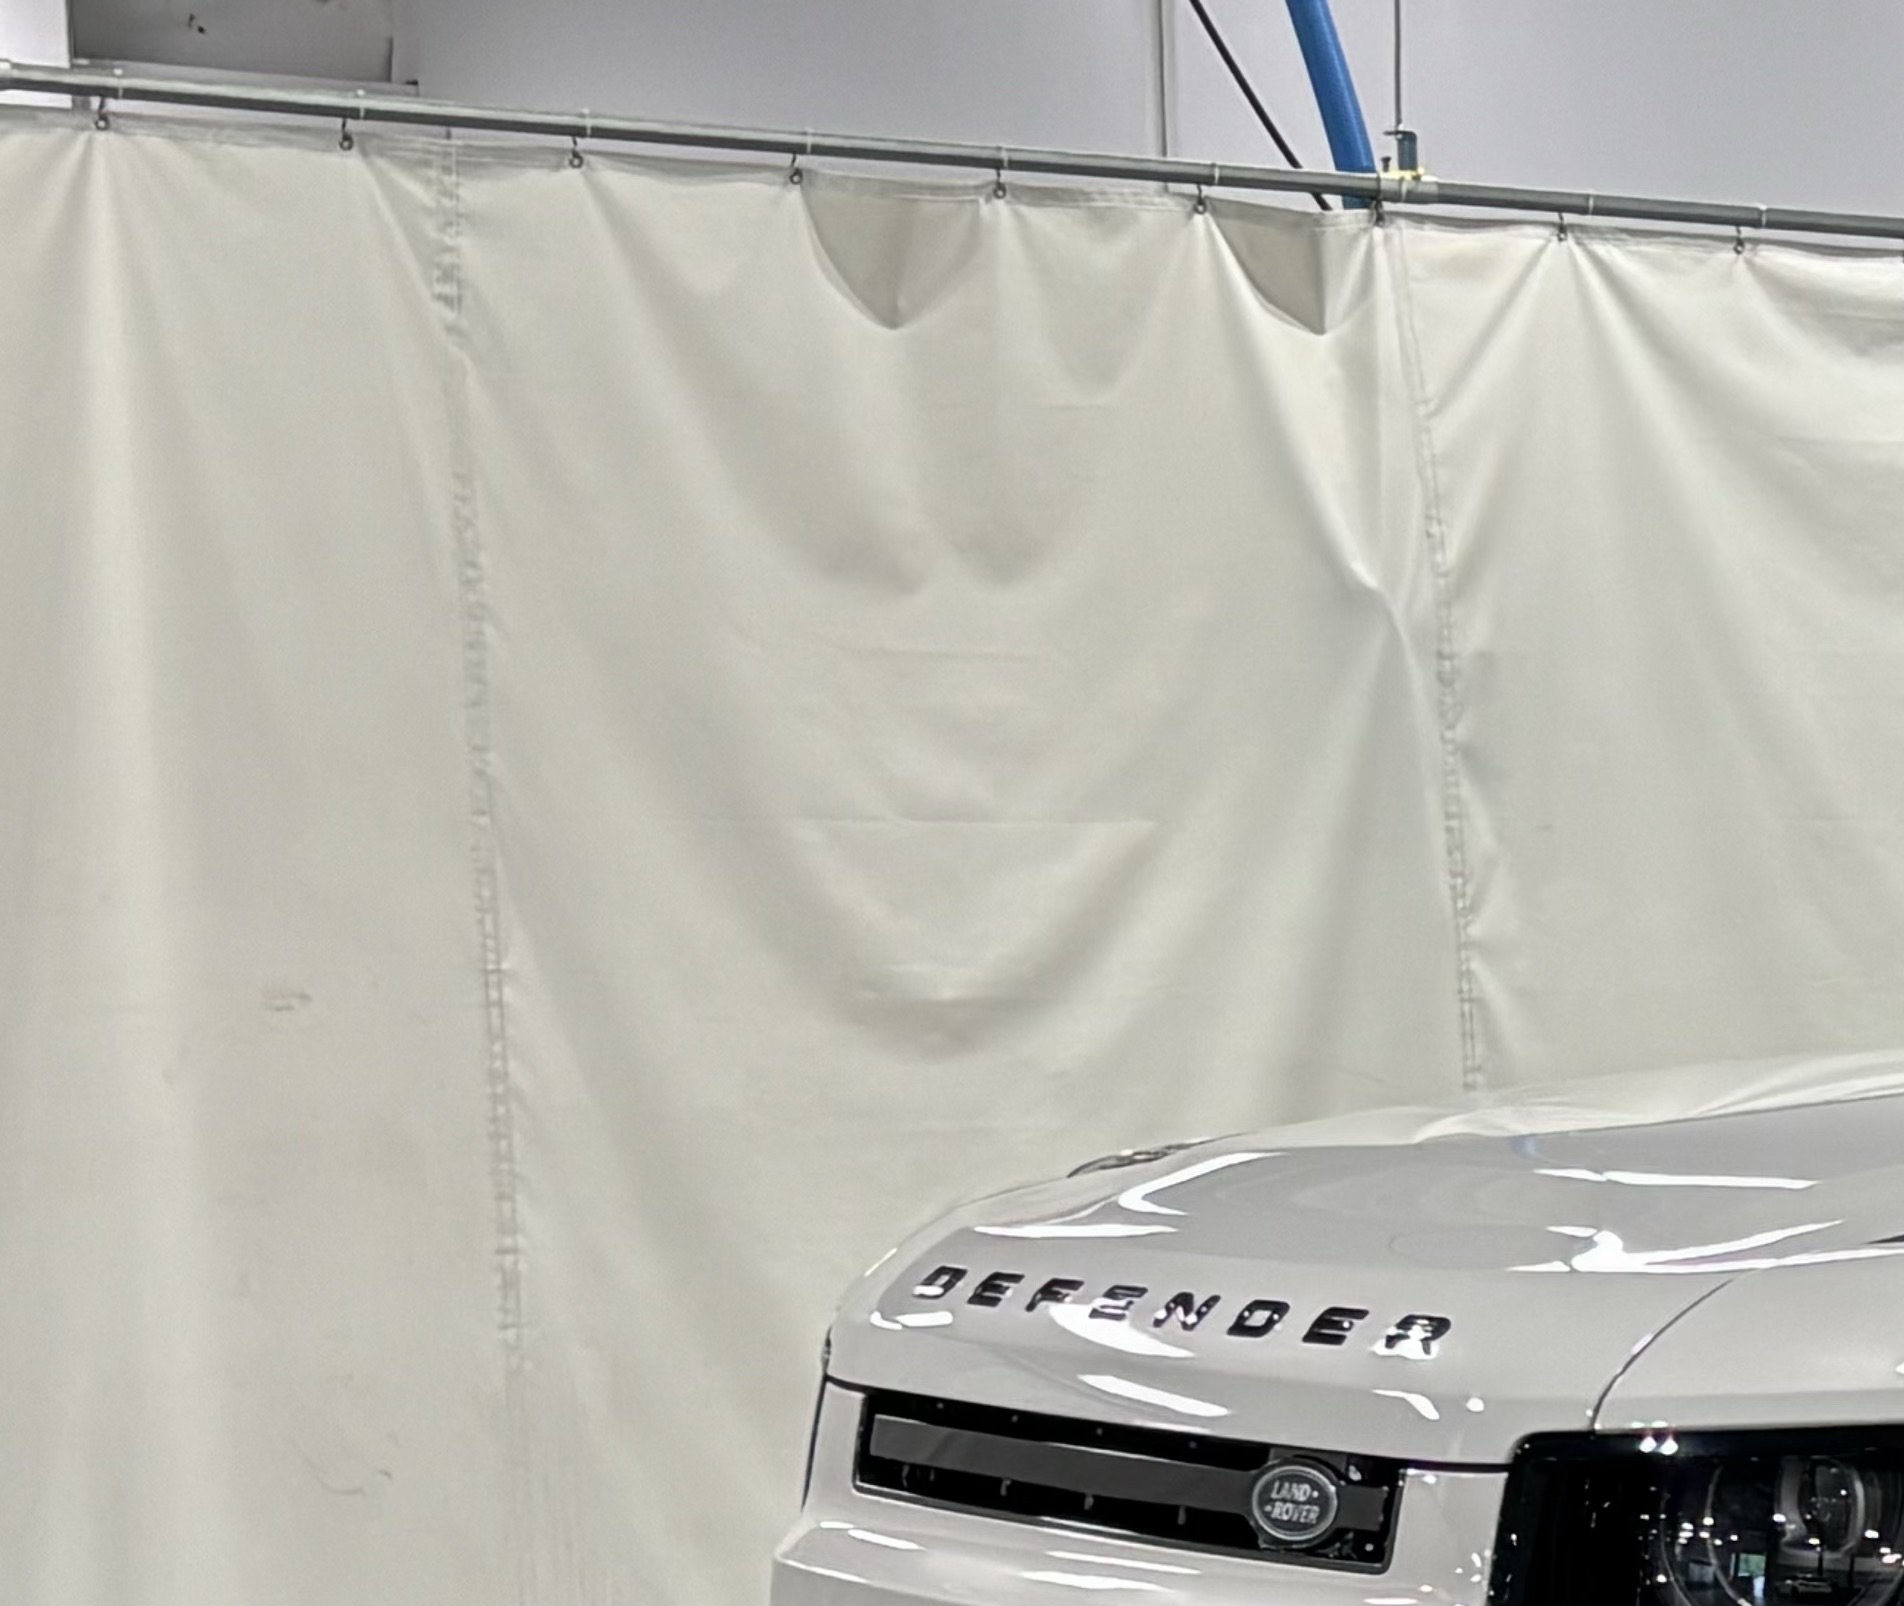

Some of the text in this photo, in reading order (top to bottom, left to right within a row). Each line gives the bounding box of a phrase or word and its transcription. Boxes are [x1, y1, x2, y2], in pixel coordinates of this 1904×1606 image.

[913, 1265, 1452, 1355] DEFENDER
[1270, 1480, 1312, 1502] LAND
[1270, 1501, 1320, 1524] ROVER
